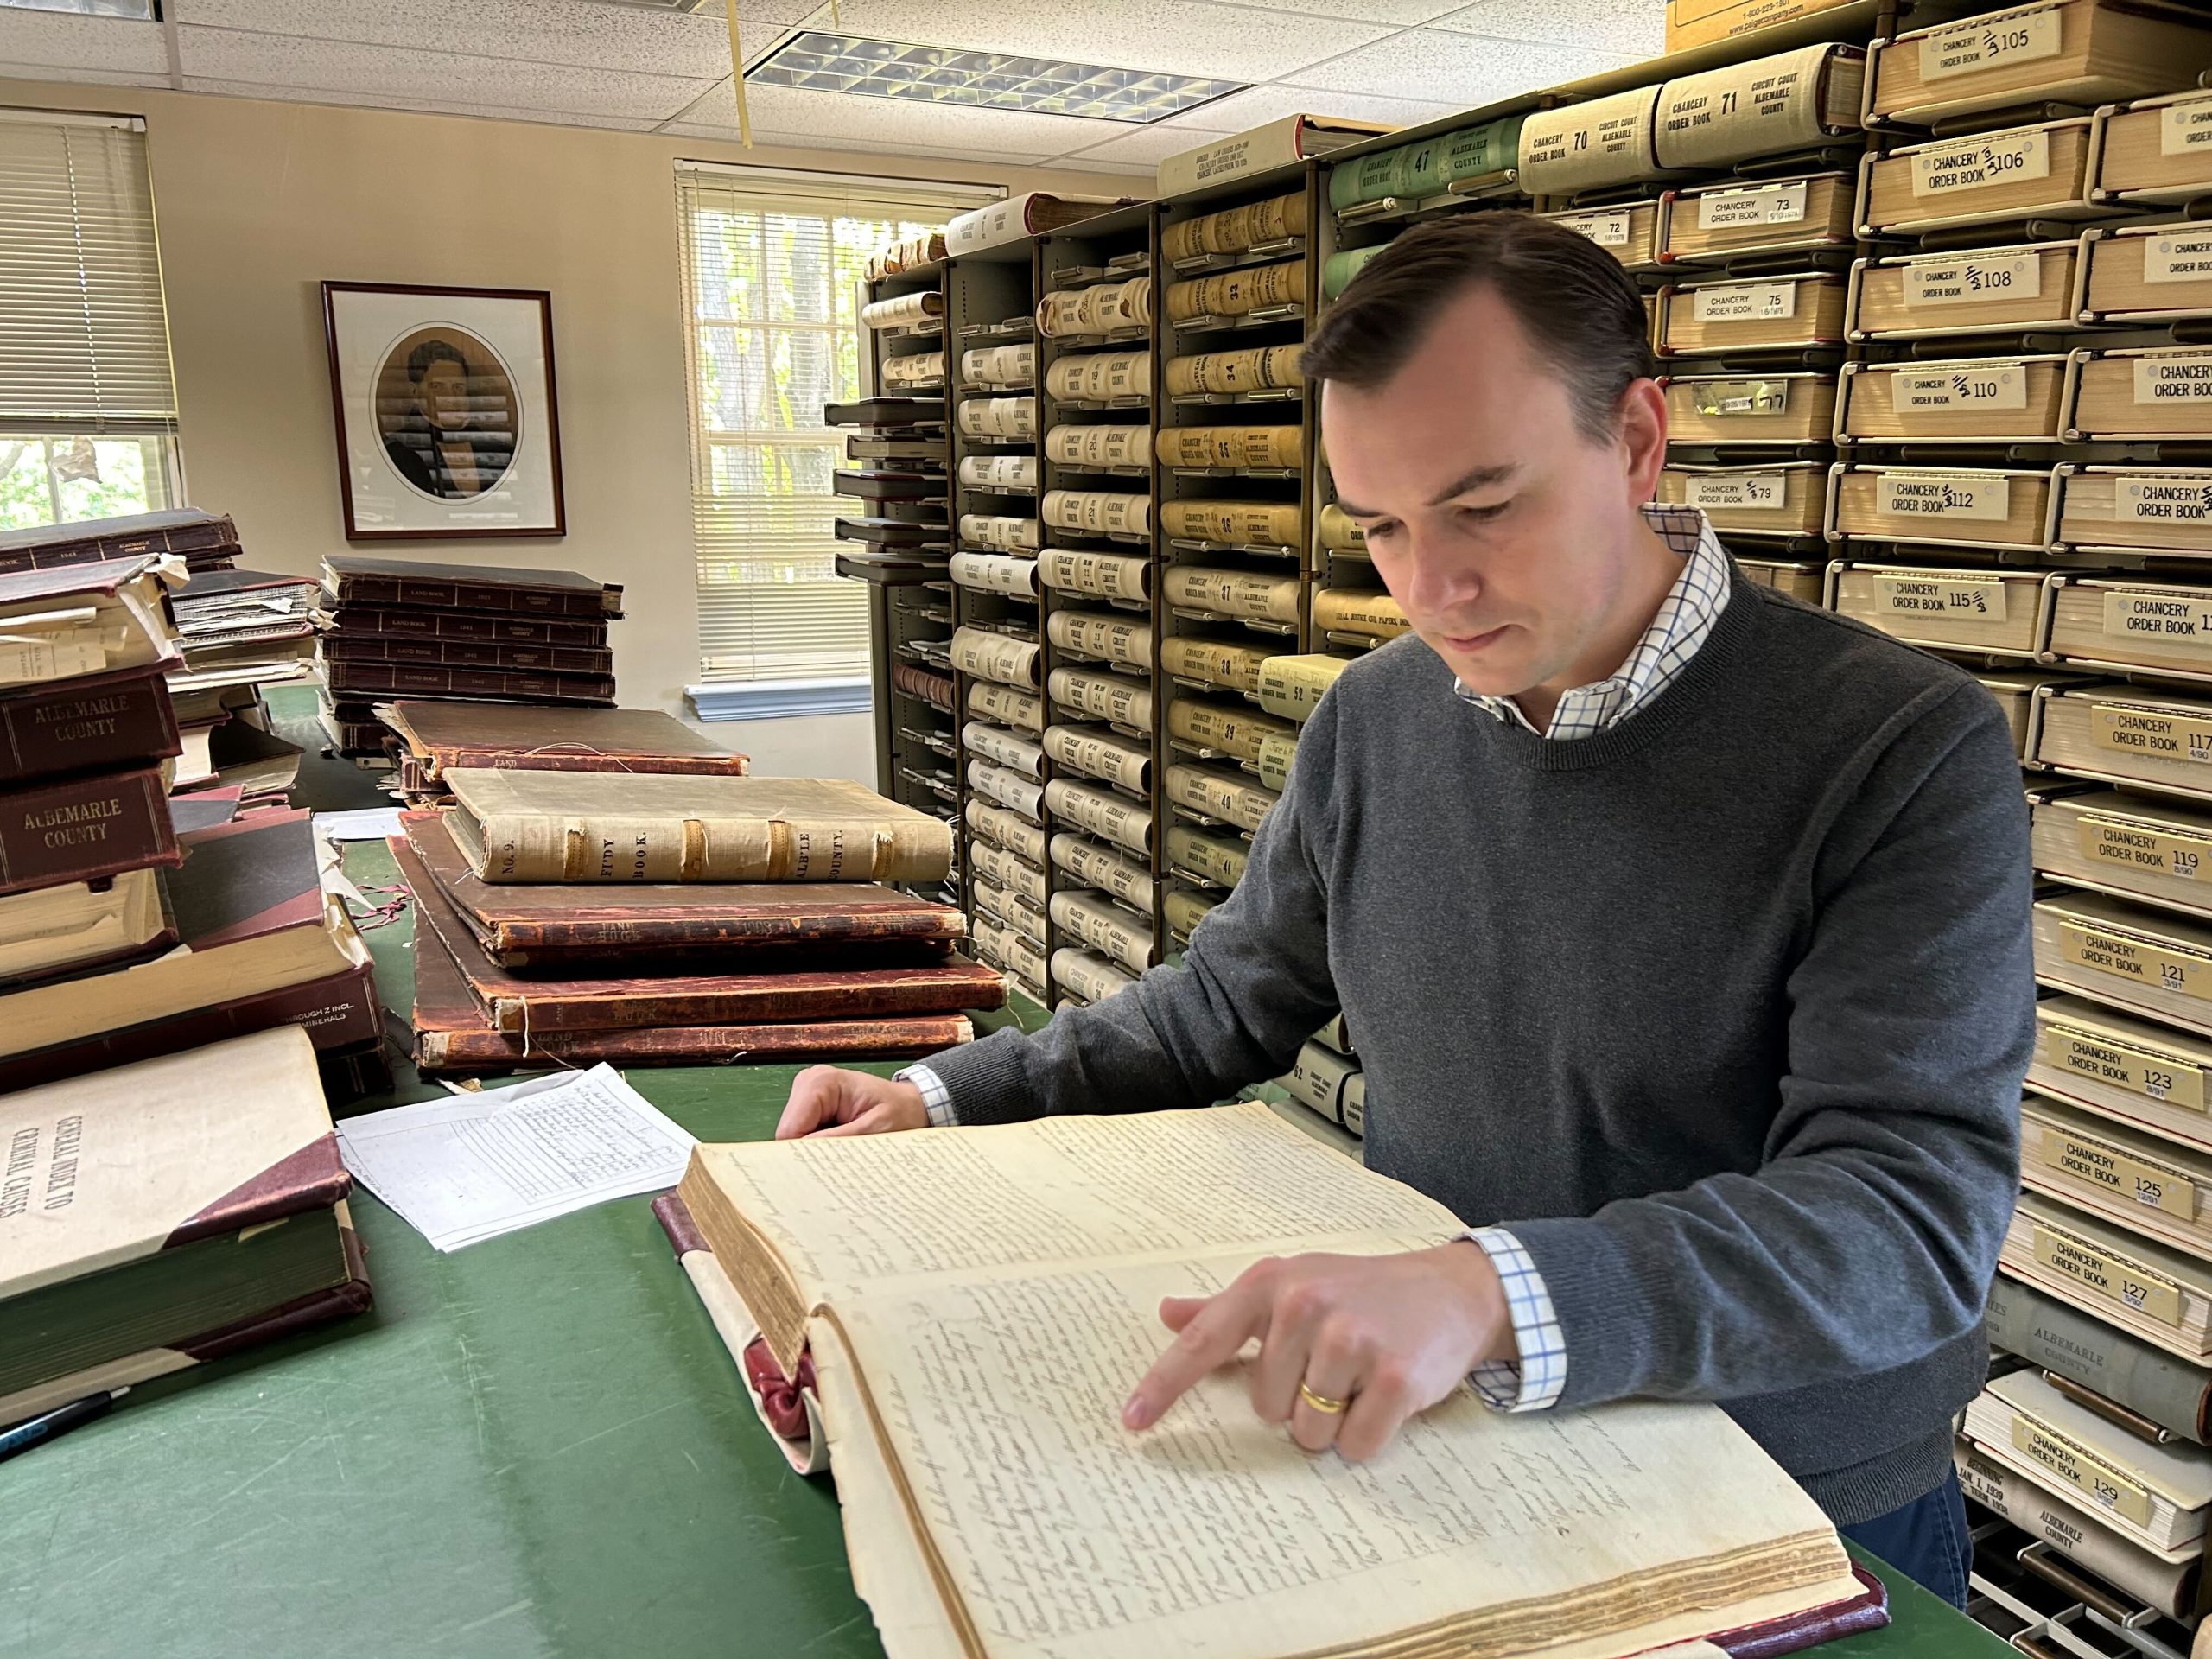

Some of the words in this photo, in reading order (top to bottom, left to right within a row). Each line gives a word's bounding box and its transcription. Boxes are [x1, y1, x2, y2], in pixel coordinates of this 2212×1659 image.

[1943, 36, 1976, 52] CHANCERY
[2001, 29, 2029, 51] 105
[1940, 55, 1961, 68] ORDER
[1962, 52, 1980, 65] BOOK
[1751, 77, 1776, 91] CIRCUIT
[1777, 73, 1798, 85] COURT
[1721, 91, 1737, 115] 71
[1754, 87, 1789, 104] ALBEMARLE
[1673, 97, 1707, 114] CHANCERY
[1761, 101, 1783, 116] COUNTY
[1599, 119, 1619, 131] CIRCUIT
[1621, 116, 1637, 126] COURT
[1668, 118, 1690, 131] ORDER
[1693, 113, 1711, 126] BOOK
[1534, 134, 1563, 149] CHANCERY
[1573, 131, 1587, 151] 70
[1602, 129, 1631, 142] ALBEMARLE
[1452, 139, 1488, 155] ALBEMARLE
[1607, 142, 1625, 153] COUNTY
[1415, 150, 1430, 173] 47
[1454, 156, 1481, 168] COUNTY
[1529, 152, 1548, 164] ORDER
[1550, 149, 1566, 160] BOOK
[1934, 152, 1978, 170] CHANCERY
[1997, 152, 2023, 172] 106
[1368, 157, 1392, 172] CHANCERY
[1363, 174, 1377, 187] ORDER
[1929, 172, 1958, 188] ORDER
[1961, 169, 1985, 186] BOOK
[1716, 200, 1756, 212] CHANCERY
[1777, 200, 1789, 210] 73
[1711, 213, 1736, 223] ORDER
[1738, 211, 1759, 219] BOOK
[1610, 224, 1620, 232] 72
[2170, 263, 2195, 273] ORDER
[1926, 270, 1957, 282] CHANCERY
[1984, 271, 2012, 287] 108
[1230, 283, 1238, 300] 33
[1923, 289, 1942, 298] ORDER
[1944, 287, 1961, 296] BOOK
[1711, 296, 1749, 305] CHANCERY
[1769, 296, 1781, 305] 75
[1091, 371, 1098, 380] 19
[1226, 365, 1235, 381] 34
[1914, 379, 1945, 389] CHANCERY
[1974, 383, 1997, 397] 110
[2155, 384, 2190, 397] ORDER
[1911, 396, 1932, 404] ORDER
[1934, 396, 1950, 404] BOOK
[1090, 441, 1096, 450] 20
[1182, 438, 1201, 447] CHANCERY
[1218, 442, 1229, 458] 35
[1759, 488, 1770, 498] 79
[1897, 483, 1939, 497] CHANCERY
[2143, 486, 2199, 501] CHANCERY
[1892, 499, 1918, 511] ORDER
[1922, 499, 1944, 512] BOOK
[1951, 493, 1973, 508] 112
[1089, 508, 1095, 517] 21
[2137, 504, 2171, 517] ORDER
[2176, 505, 2205, 518] BOOK
[1222, 518, 1230, 533] 36
[1222, 586, 1230, 601] 37
[1896, 583, 1938, 595] CHANCERY
[1893, 597, 1917, 609] ORDER
[1919, 598, 1945, 611] BOOK
[1949, 593, 1970, 607] 115
[2133, 601, 2190, 617] CHANCERY
[1379, 617, 1398, 626] PAPERS,
[2127, 617, 2161, 632] ORDER
[2166, 620, 2195, 635] BOOK
[1221, 659, 1230, 675] 38
[1265, 678, 1284, 688] CHANCERY
[1262, 688, 1274, 697] ORDER
[1294, 686, 1303, 701] 52
[35, 695, 129, 724] ALBEMARLE
[55, 718, 116, 741] COUNTY
[1224, 724, 1235, 740] 39
[2119, 715, 2171, 734] CHANCERY
[2113, 732, 2145, 747] ORDER
[2150, 736, 2179, 751] BOOK
[2189, 734, 2212, 750] 117
[1266, 755, 1284, 766] CHANCERY
[2190, 750, 2209, 759] 4/90
[494, 759, 517, 768] LAND
[1263, 765, 1274, 774] ORDER
[1221, 795, 1230, 810] 40
[24, 798, 122, 830] ALBEMARLE
[44, 823, 107, 849] COUNTY
[2103, 830, 2156, 849] CHANCERY
[796, 834, 810, 878] ALB'LE
[2099, 844, 2132, 860] ORDER
[2135, 851, 2163, 867] BOOK
[2173, 851, 2198, 868] 119
[1223, 859, 1230, 874] 41
[2174, 866, 2193, 875] 8/90
[2086, 935, 2136, 958] CHANCERY
[2081, 949, 2112, 966] ORDER
[2116, 958, 2143, 975] BOOK
[2160, 963, 2185, 982] 121
[2164, 978, 2183, 989] 3/91
[332, 1003, 354, 1012] INCL.
[302, 1014, 346, 1028] MINERALS
[2072, 1042, 2121, 1065] CHANCERY
[1294, 1065, 1303, 1080] 62
[2068, 1055, 2099, 1073] ORDER
[2103, 1065, 2129, 1083] BOOK
[2144, 1070, 2171, 1090] 123
[2146, 1085, 2164, 1096] 8/91
[53, 1116, 82, 1160] GENERAL
[7, 1128, 39, 1176] CRIMINAL
[2066, 1143, 2115, 1170] CHANCERY
[47, 1157, 78, 1193] INDEX
[2061, 1156, 2091, 1176] ORDER
[2095, 1168, 2120, 1186] BOOK
[2136, 1177, 2162, 1198] 125
[0, 1177, 31, 1218] CAUSES
[44, 1191, 73, 1210] TO
[2057, 1243, 2103, 1271] CHANCERY
[2051, 1255, 2081, 1276] ORDER
[2084, 1267, 2108, 1289] BOOK
[2122, 1281, 2147, 1300] 127
[2034, 1327, 2104, 1367] ALBEMARLE
[2045, 1347, 2090, 1375] COUNTY
[2033, 1433, 2076, 1466] CHANCERY
[1967, 1457, 2003, 1485] BEGINNING
[2027, 1444, 2055, 1471] ORDER
[2057, 1459, 2082, 1483] BOOK
[2094, 1478, 2119, 1502] 129
[1959, 1468, 1973, 1484] JAN.
[1986, 1484, 2003, 1501] 1939
[1970, 1486, 1988, 1503] TERM
[1993, 1499, 2008, 1515] 1938
[2040, 1511, 2082, 1543] ALBEMARLE
[2045, 1526, 2073, 1548] COUNTY
